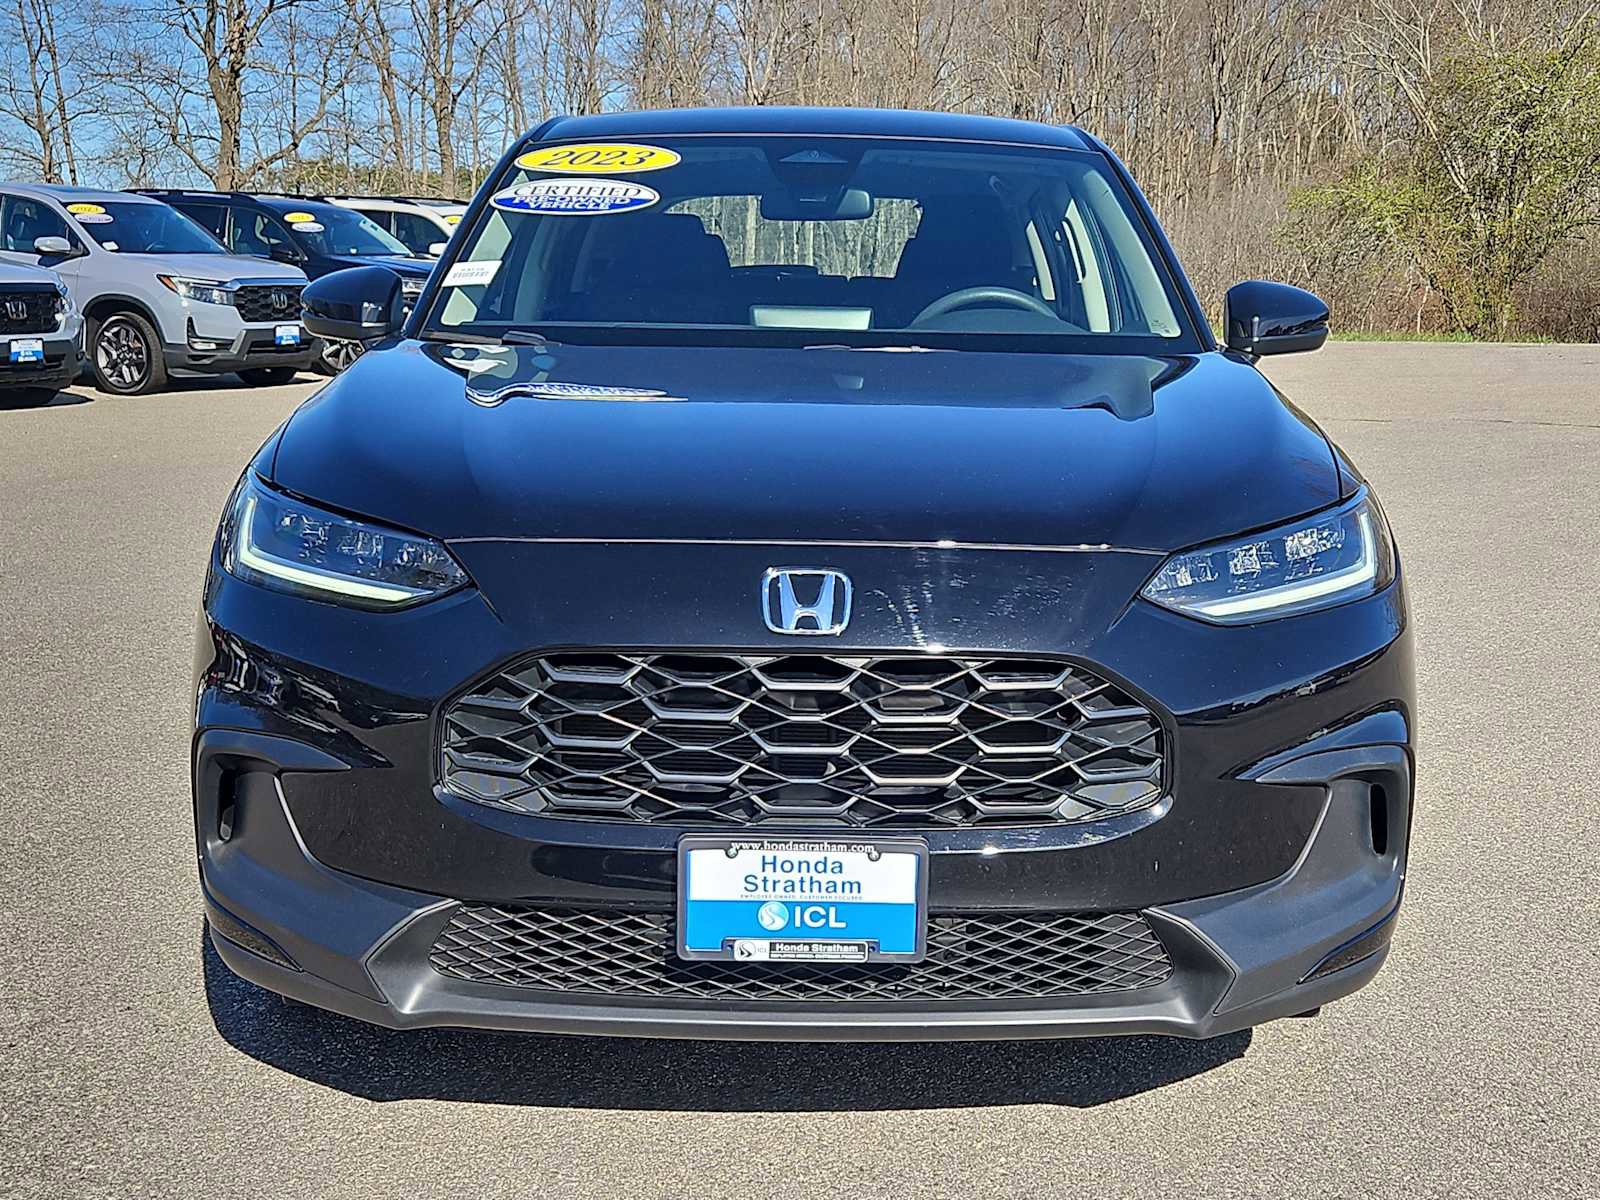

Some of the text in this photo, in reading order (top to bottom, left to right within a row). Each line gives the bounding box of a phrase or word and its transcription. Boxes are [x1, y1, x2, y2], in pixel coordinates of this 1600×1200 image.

[540, 150, 656, 166] 2023
[514, 185, 642, 197] CERTIFIED
[512, 195, 632, 205] PRE-OWNED
[528, 201, 611, 210] VEHICLE
[730, 840, 876, 853] www.hondastratham.com
[761, 855, 844, 874] Honda
[743, 874, 862, 894] Stratham
[794, 905, 848, 929] ICL
[775, 942, 859, 953] Honda Stratham
